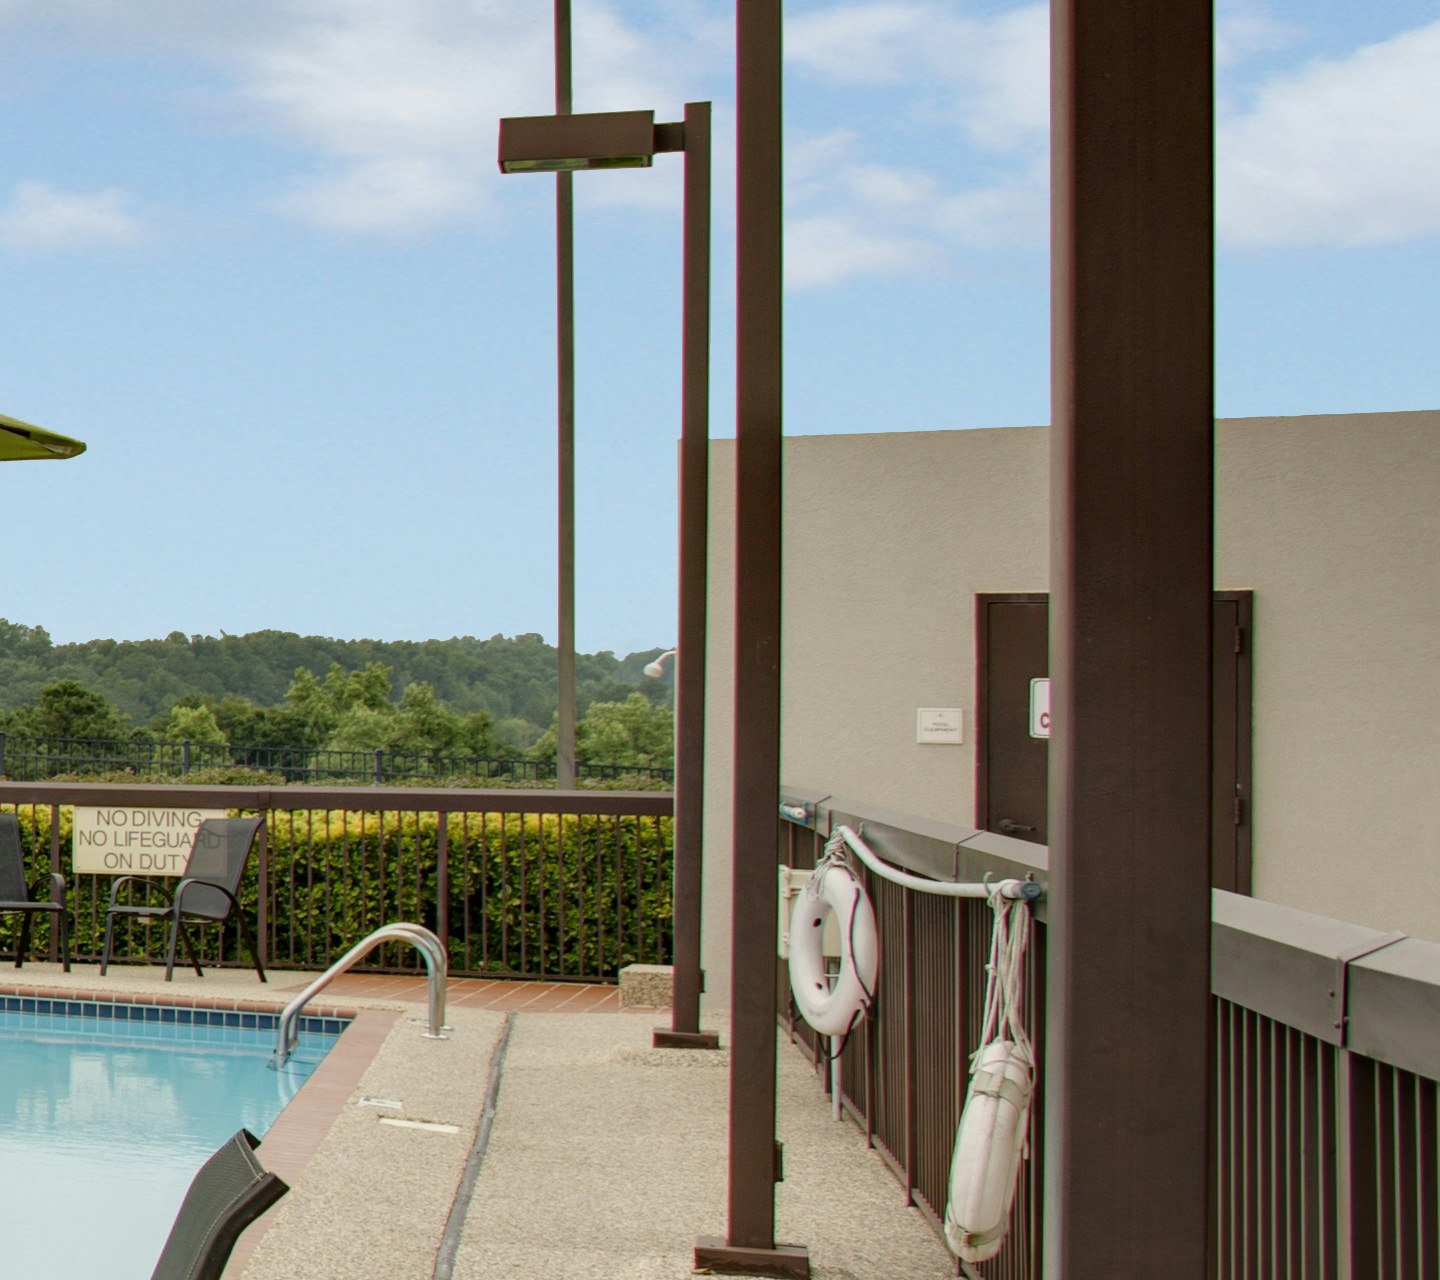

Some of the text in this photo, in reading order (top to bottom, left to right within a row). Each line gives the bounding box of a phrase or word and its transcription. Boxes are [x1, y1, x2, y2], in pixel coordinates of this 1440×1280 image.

[96, 809, 202, 828] NO DIVING
[79, 830, 221, 849] NO LIFEGUARD
[104, 852, 133, 869] ON
